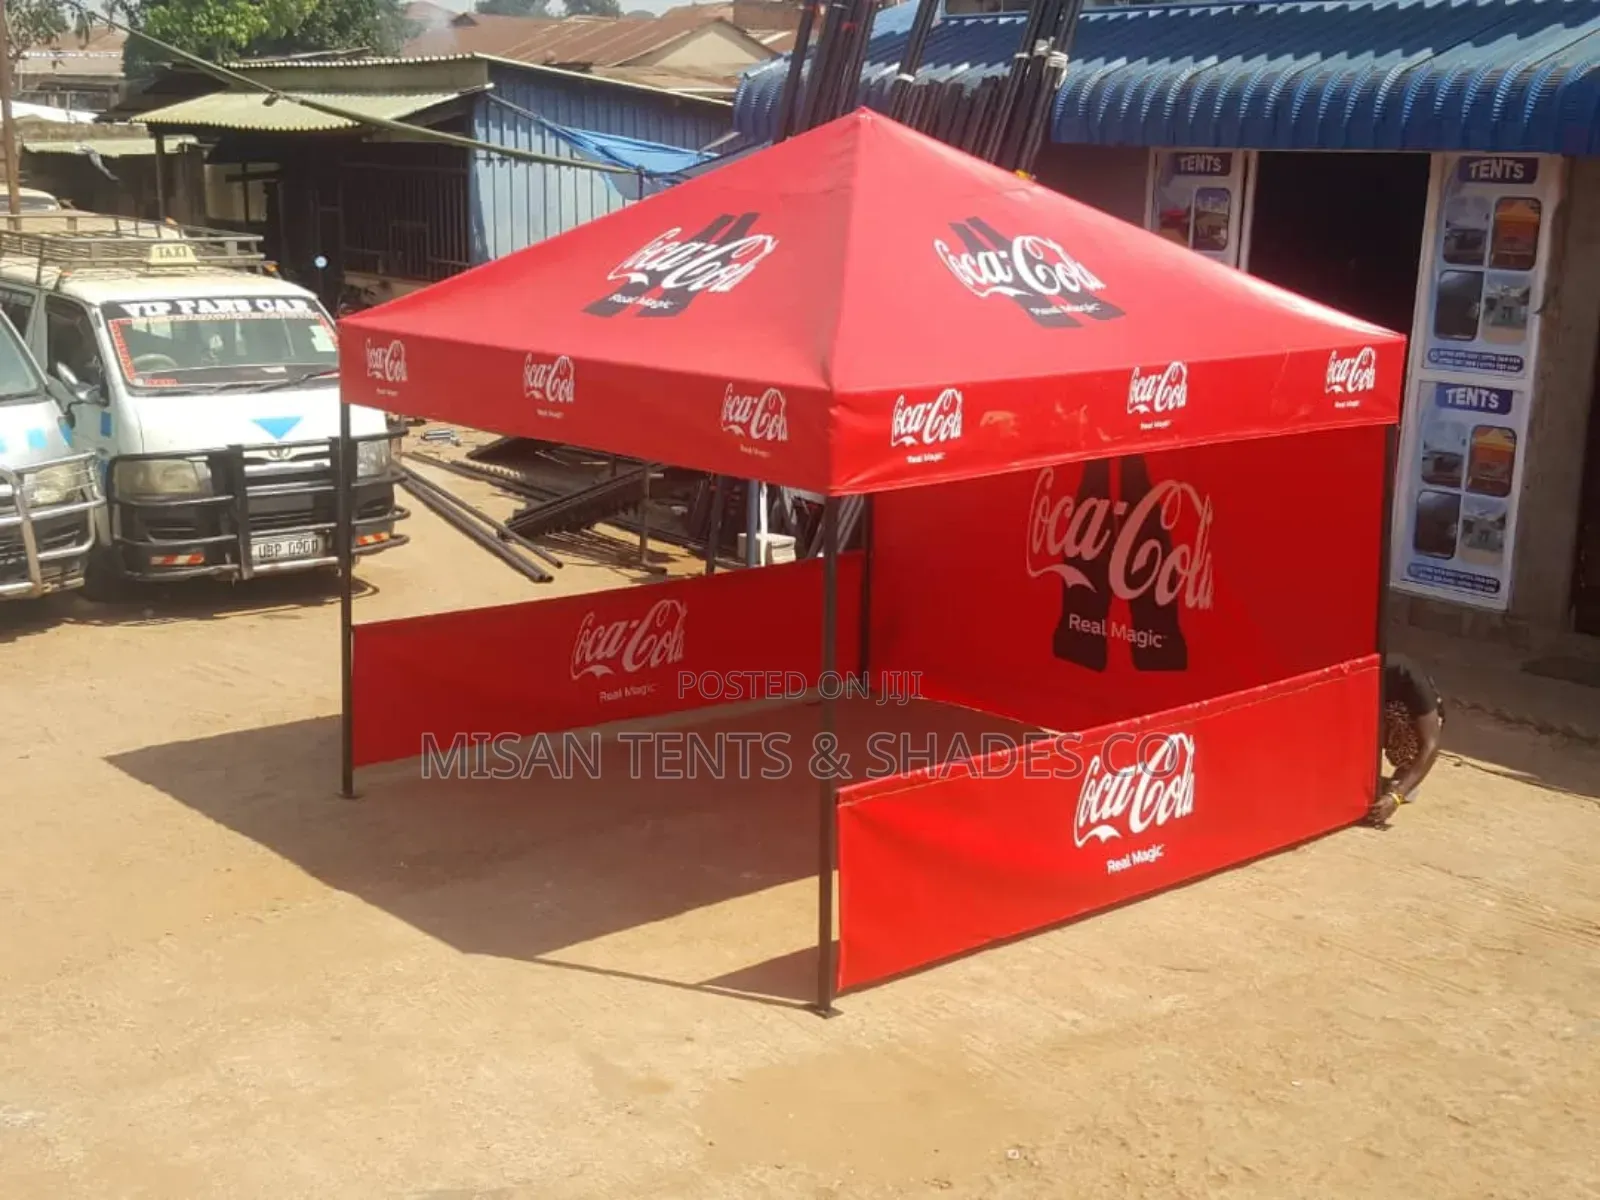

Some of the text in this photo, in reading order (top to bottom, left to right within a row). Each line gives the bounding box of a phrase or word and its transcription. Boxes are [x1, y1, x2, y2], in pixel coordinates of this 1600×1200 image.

[1181, 154, 1221, 172] TENTS
[1469, 157, 1524, 179] TENTS
[158, 245, 187, 257] TAXI
[934, 235, 1107, 299] Coca-Cola
[119, 302, 171, 317] VIP
[1445, 387, 1499, 409] TENTS
[1026, 466, 1214, 610] Coca-Cola
[259, 542, 282, 557] UBP
[570, 599, 687, 680] Coca-Cola
[1068, 612, 1165, 648] Real Magic
[599, 687, 622, 703] Real
[1073, 732, 1195, 848] Coca-Cola
[1106, 844, 1165, 874] Real Magic
